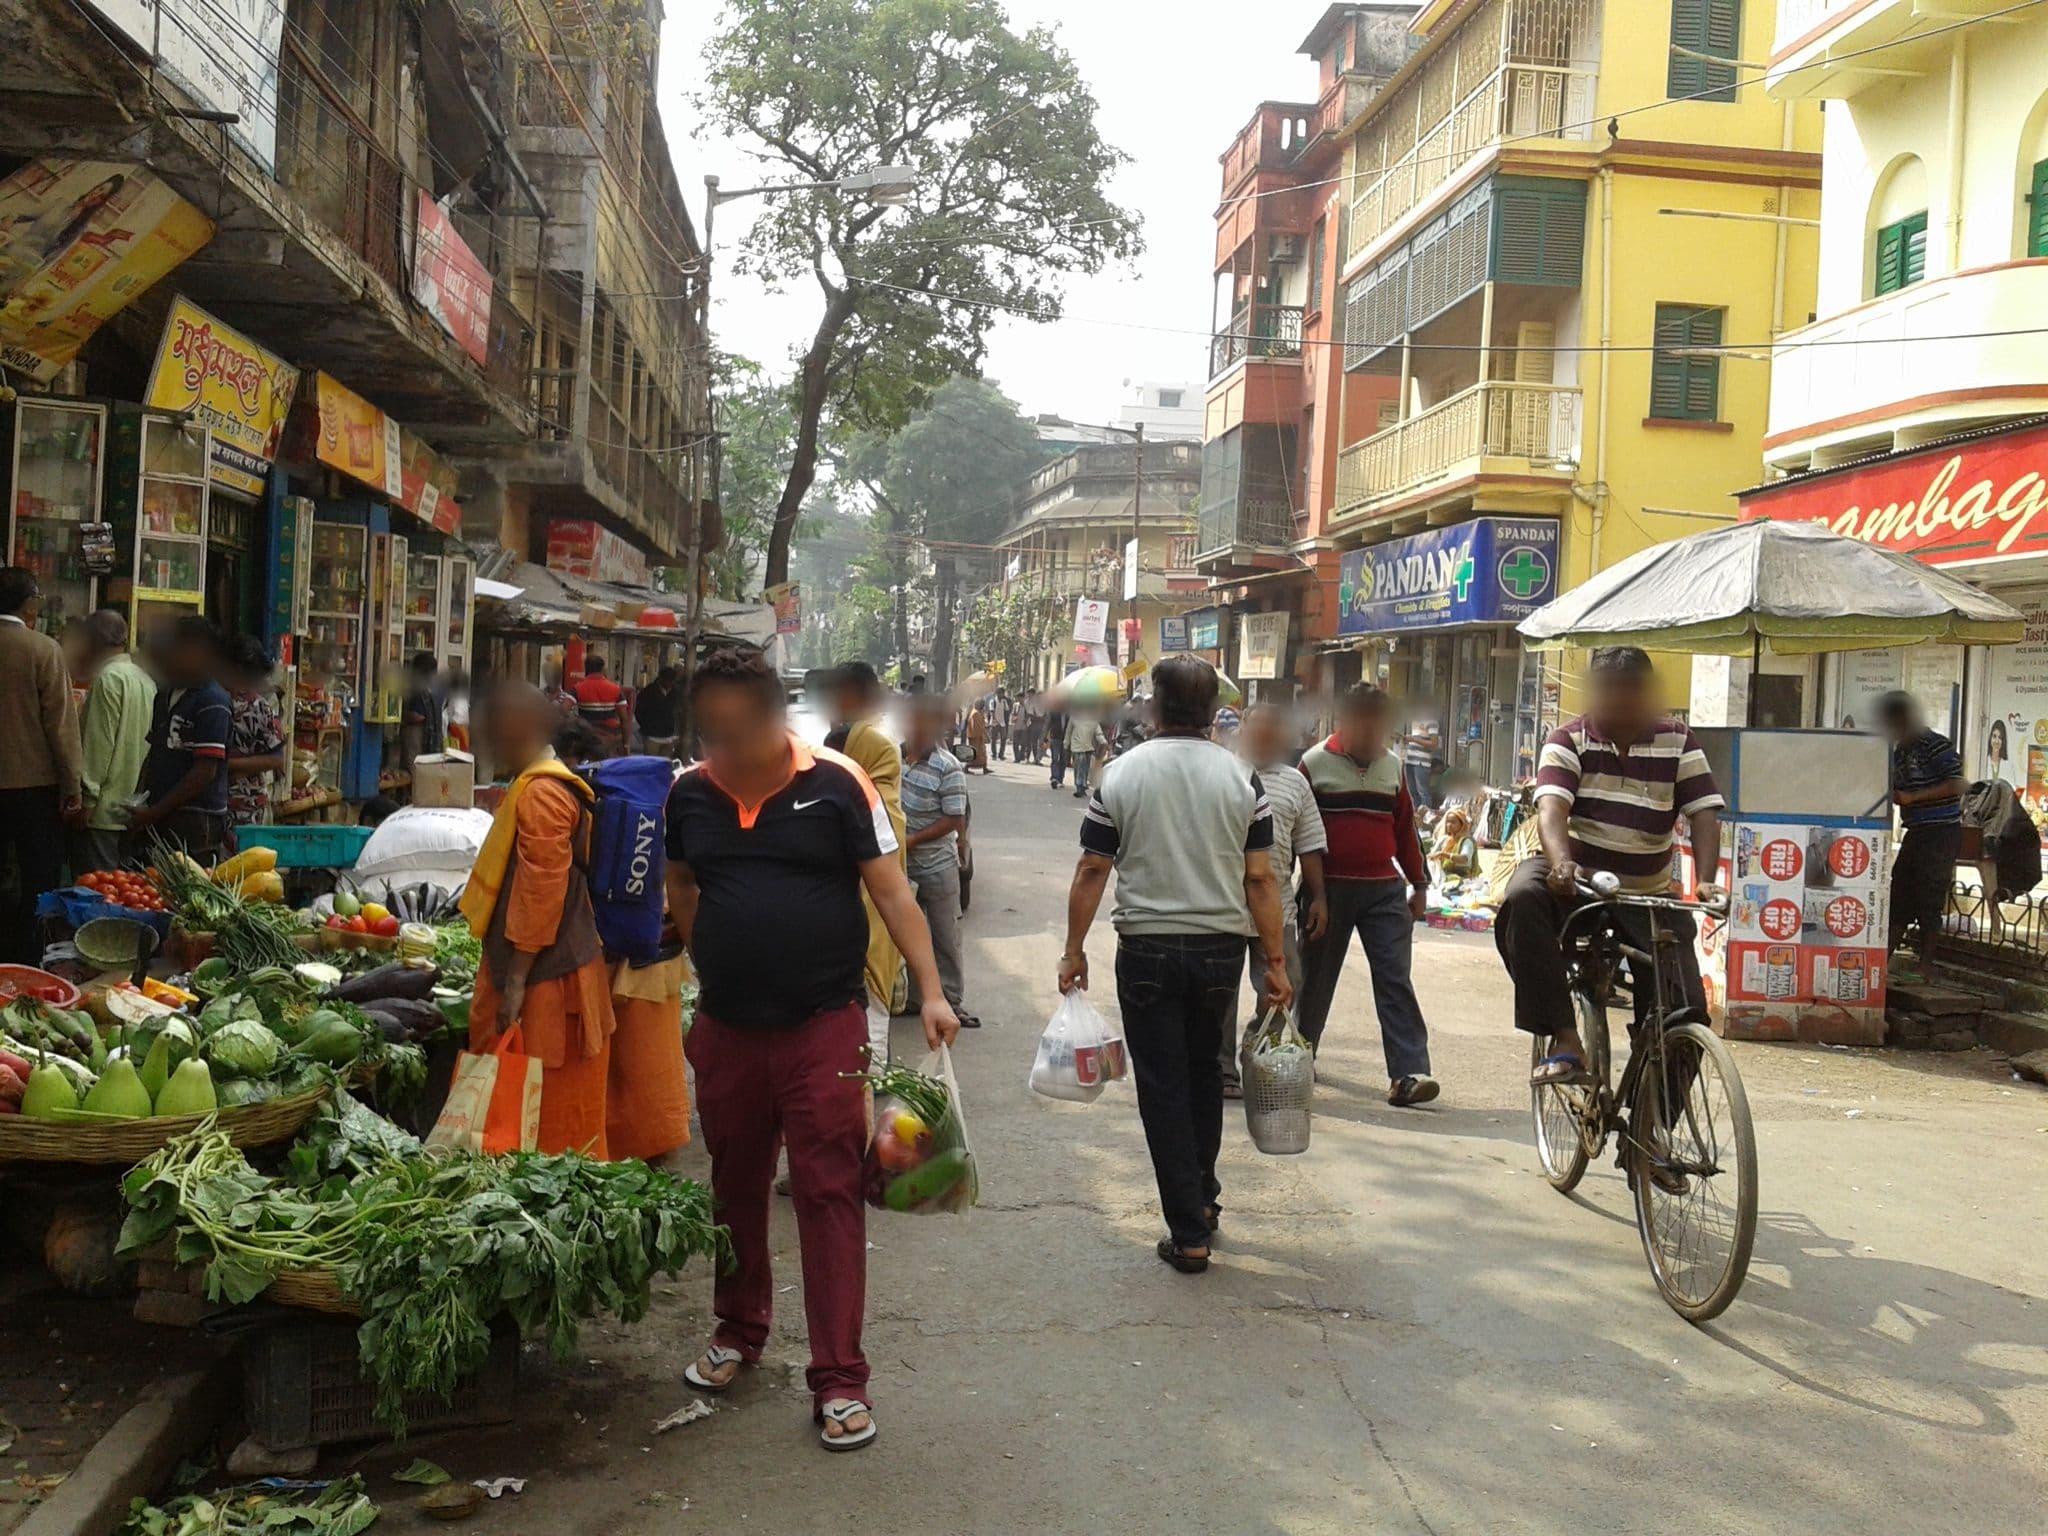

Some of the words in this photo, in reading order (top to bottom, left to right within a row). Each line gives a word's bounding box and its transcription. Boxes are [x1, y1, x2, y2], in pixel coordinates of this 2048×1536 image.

[1497, 526, 1554, 541] SPANDAN
[1354, 546, 1456, 611] SPANDAN
[625, 812, 656, 896] SONY
[1770, 843, 1786, 876] FREE
[1764, 906, 1779, 930] OFF
[1780, 907, 1796, 936] 25%
[1829, 902, 1842, 930] OFF
[1842, 900, 1856, 933] 25%
[1856, 906, 1864, 926] FLAT
